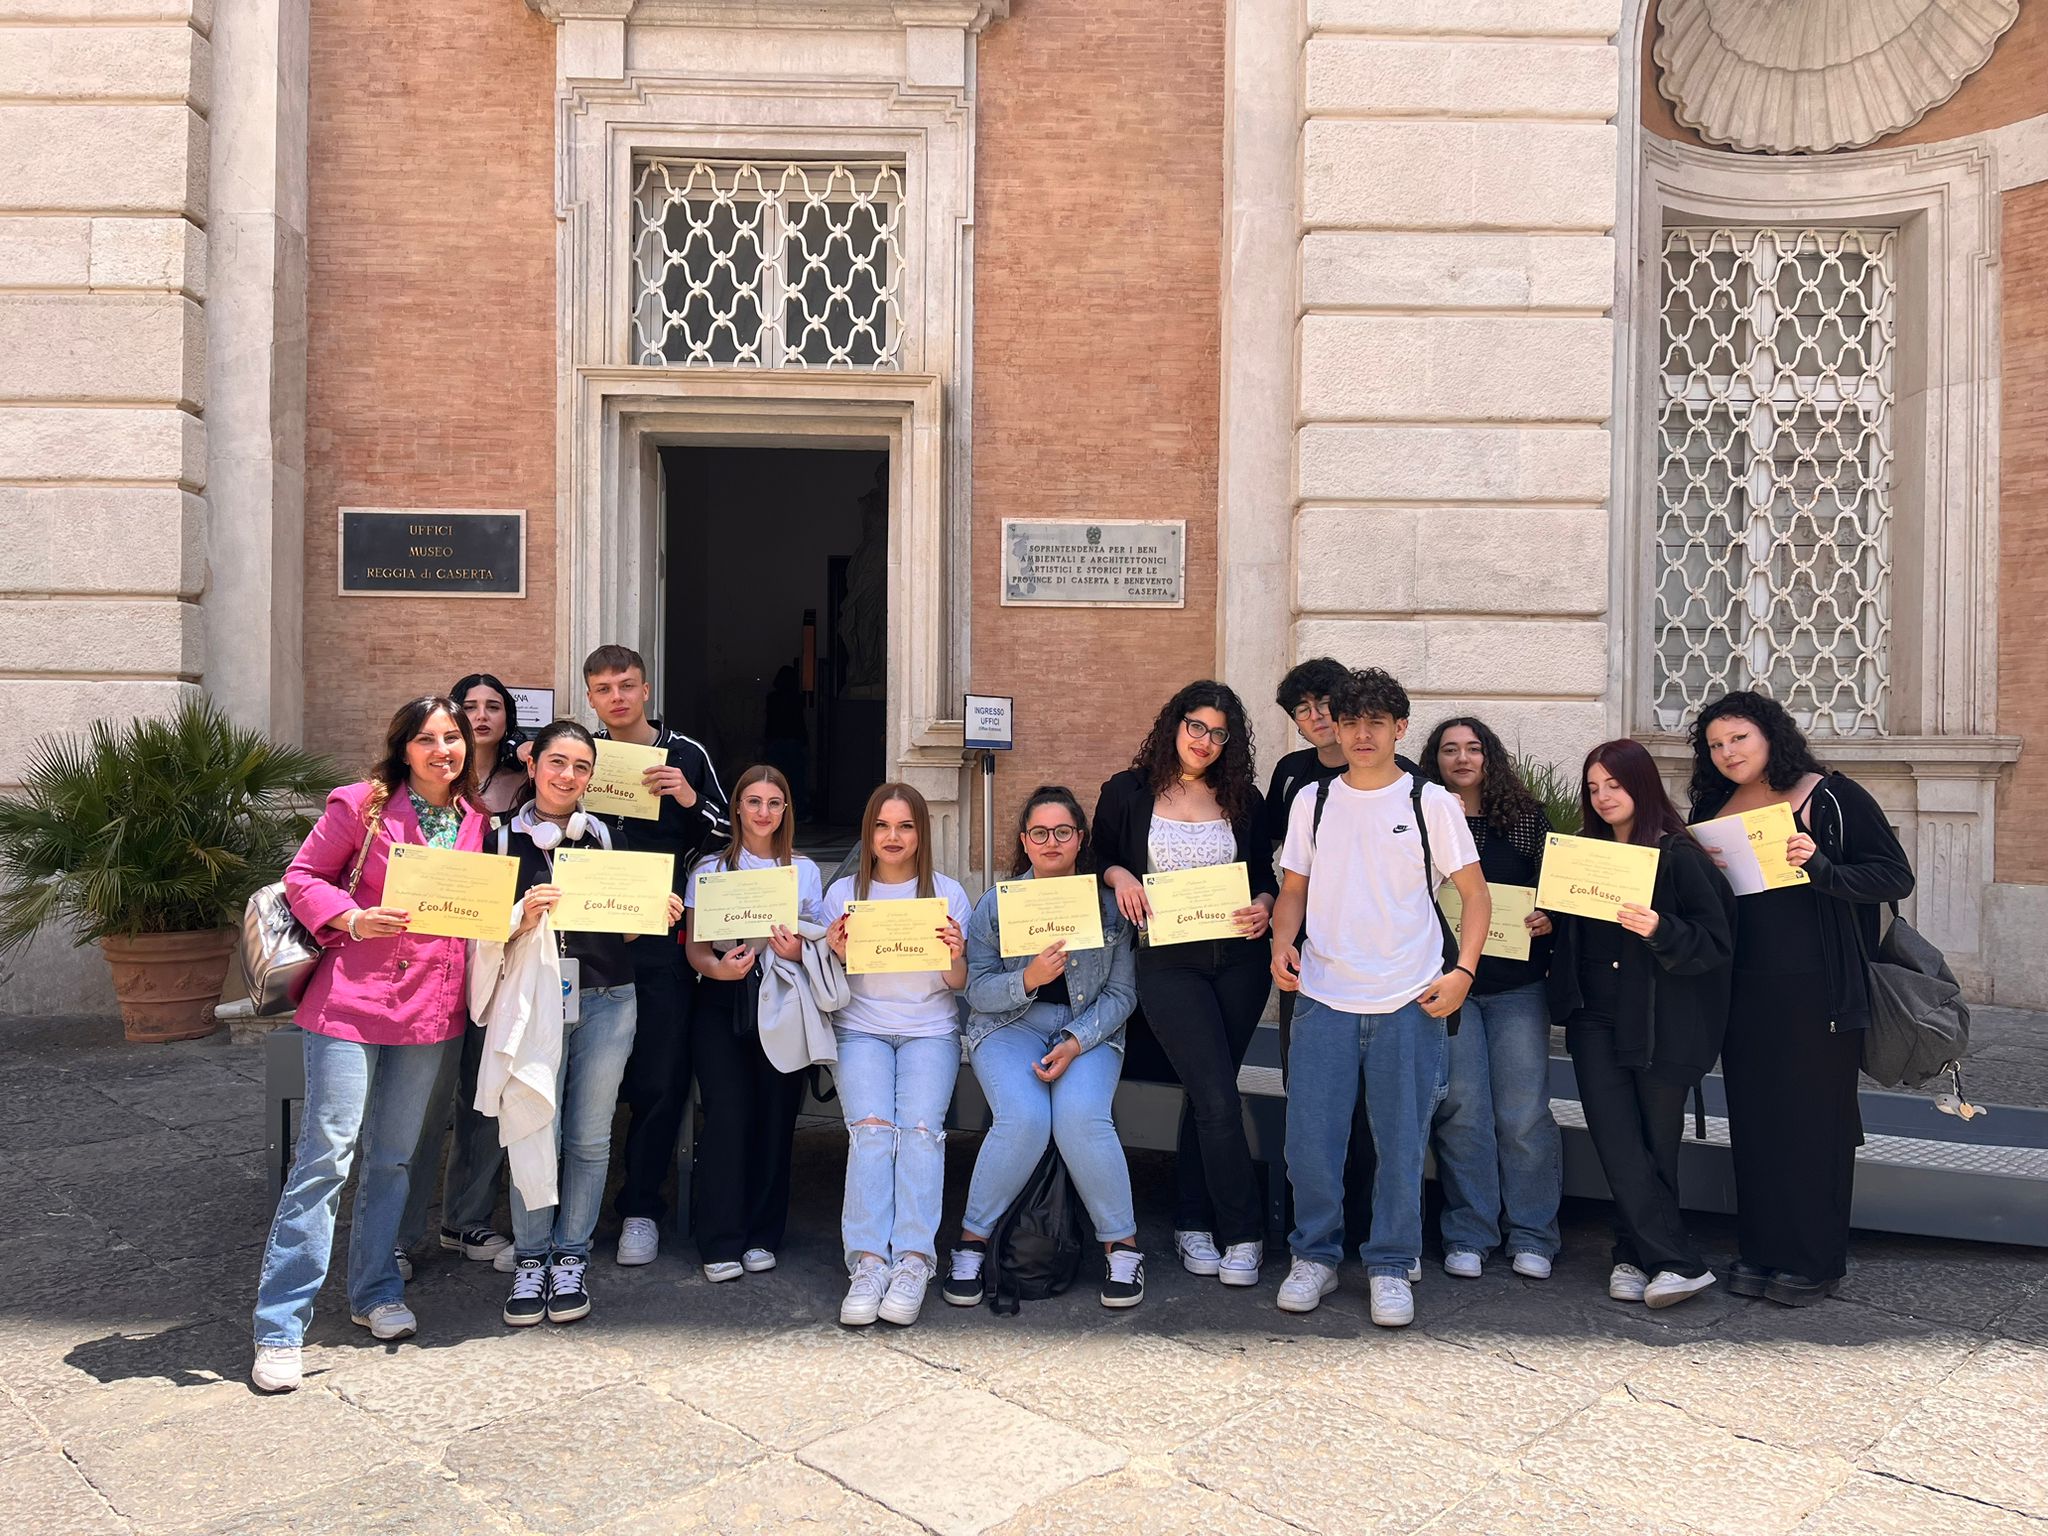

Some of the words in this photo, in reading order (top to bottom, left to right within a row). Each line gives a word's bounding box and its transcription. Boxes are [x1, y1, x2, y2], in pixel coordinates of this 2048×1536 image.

[409, 525, 453, 536] UFFICI
[409, 547, 454, 558] MUSEO
[1029, 545, 1105, 554] SOPRINTENDENZA
[1109, 546, 1125, 554] PER
[1129, 546, 1133, 554] I
[1137, 546, 1157, 554] BENI
[1020, 555, 1076, 563] AMBIENTALI
[1090, 556, 1167, 565] ARCHITETTONICI
[367, 567, 416, 579] REGGIA
[420, 568, 431, 579] di
[436, 568, 494, 580] CASERTA
[1076, 566, 1082, 574] E
[1086, 566, 1122, 574] STORICI
[1126, 566, 1143, 574] PER
[1146, 567, 1158, 575] LE
[1012, 576, 1052, 584] PROVINCE
[1056, 576, 1066, 584] DI
[1071, 576, 1109, 585] CASERTA
[1113, 577, 1119, 585] E
[1124, 577, 1173, 585] BENEVENTO
[1128, 587, 1168, 595] CASERTA
[974, 706, 1004, 716] INGRESSO
[980, 717, 1000, 726] UFFICI
